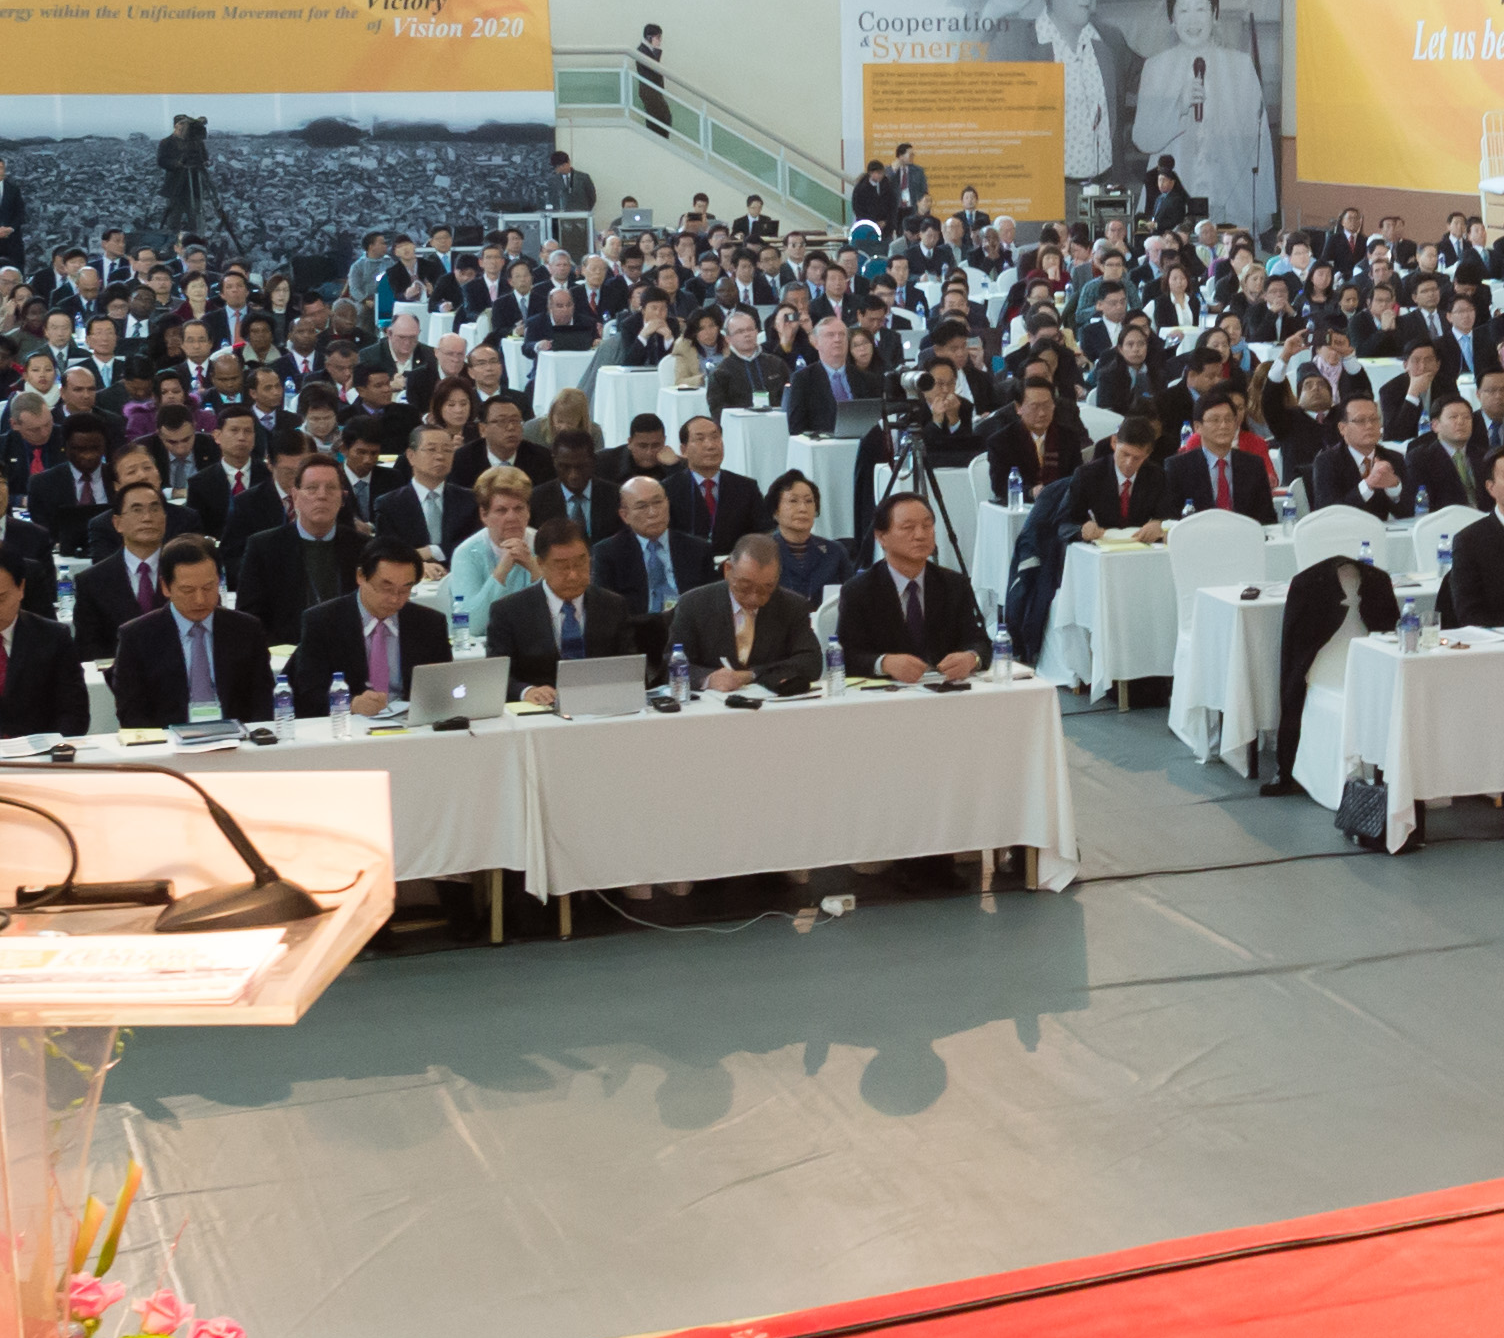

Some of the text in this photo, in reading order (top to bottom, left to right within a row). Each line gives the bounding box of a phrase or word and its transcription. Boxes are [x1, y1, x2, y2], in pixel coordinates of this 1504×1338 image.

[40, 4, 90, 19] within
[96, 5, 121, 19] the
[127, 5, 220, 23] Unification
[222, 5, 304, 20] Movement
[306, 5, 331, 23] for
[335, 5, 359, 20] the
[858, 11, 1011, 36] Cooperation
[366, 16, 524, 39] of Vision 2020
[872, 33, 991, 63] Synergy
[1412, 19, 1447, 62] Let
[1449, 32, 1476, 62] us
